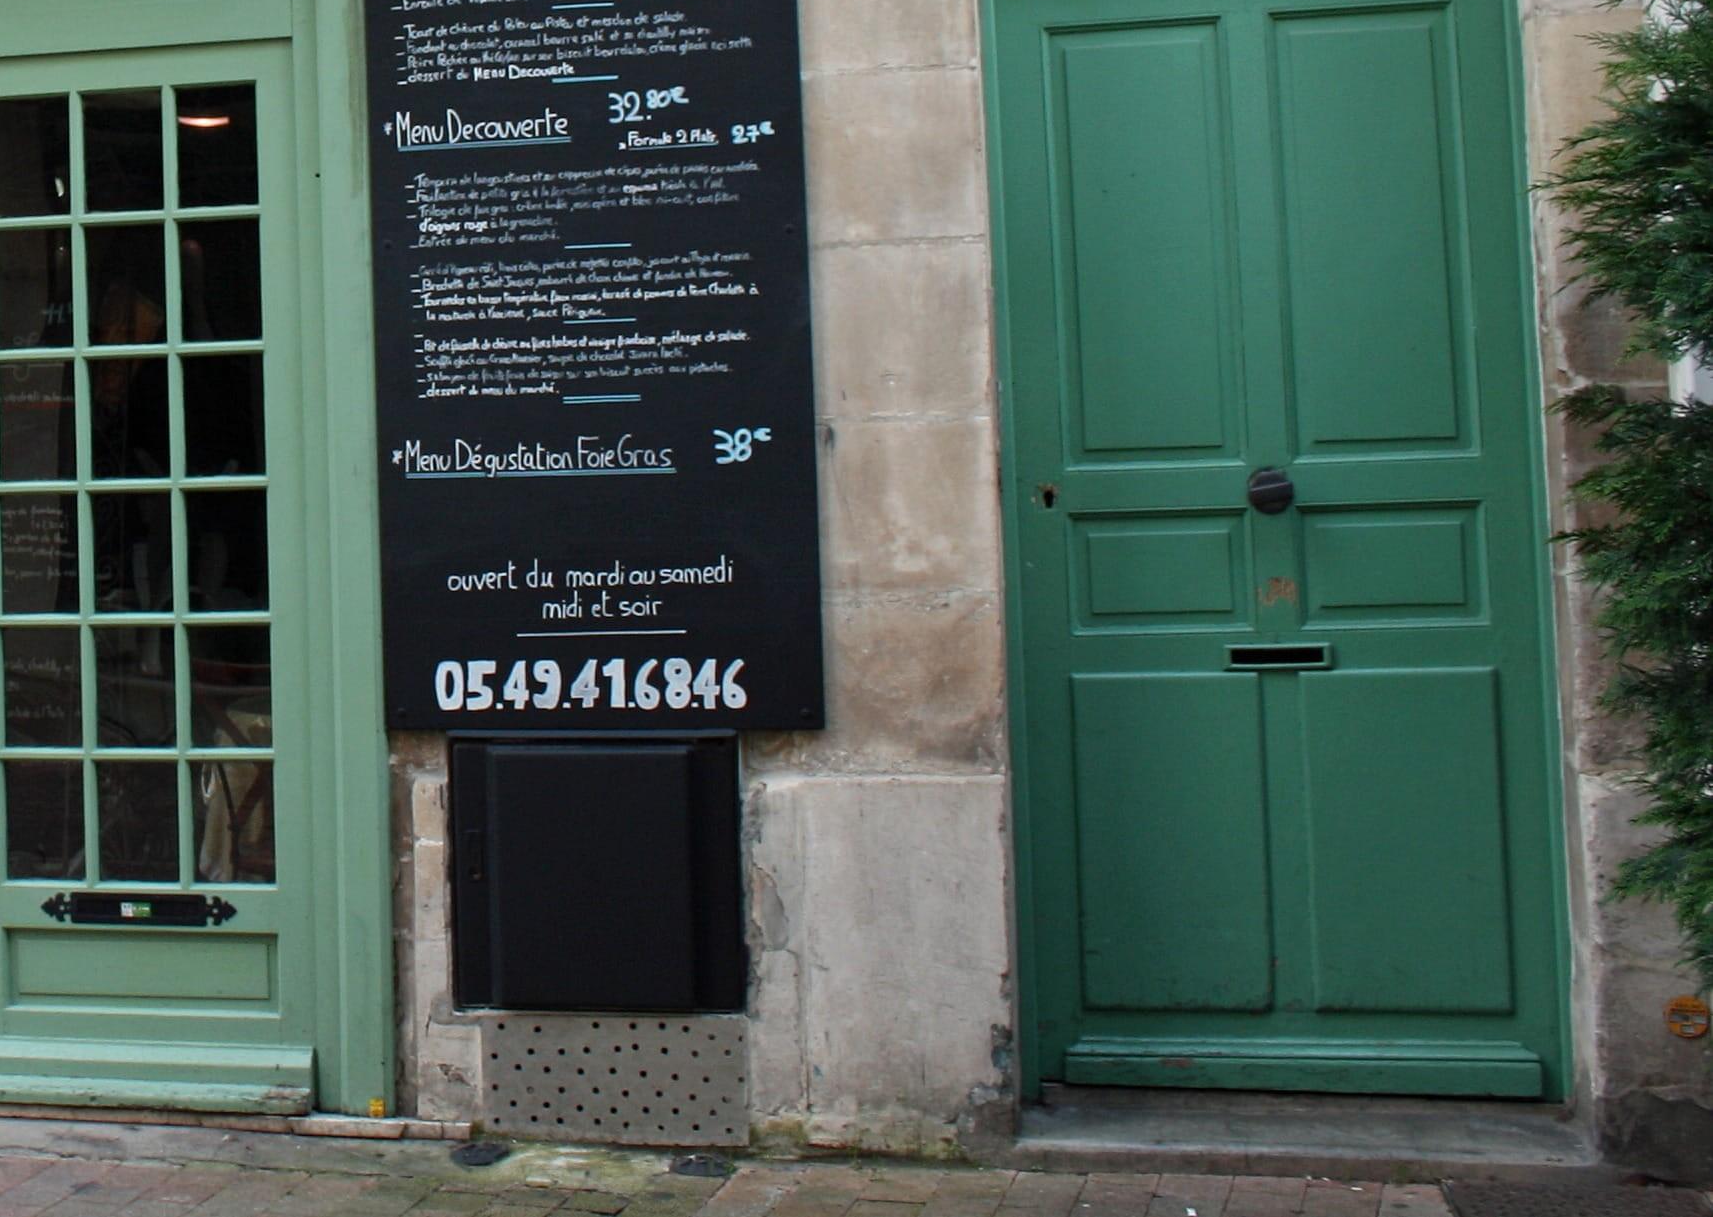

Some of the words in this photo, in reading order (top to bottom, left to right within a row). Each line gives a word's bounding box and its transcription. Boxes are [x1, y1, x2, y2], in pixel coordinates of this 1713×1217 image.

[609, 86, 689, 123] 32.80€
[396, 112, 444, 145] Menu
[447, 108, 568, 143] Decouverte
[676, 129, 687, 143] 2
[732, 121, 775, 144] 27€
[405, 440, 451, 472] Menu
[455, 439, 574, 477] Dégustation
[578, 436, 615, 468] Foie
[617, 434, 672, 467] Gras
[714, 428, 771, 464] 38€
[448, 561, 518, 591] ouvert
[526, 559, 554, 588] du
[566, 560, 624, 588] mardi
[629, 571, 656, 585] au
[660, 555, 733, 584] samedi
[543, 590, 582, 619] midi
[592, 590, 613, 617] et
[619, 595, 662, 616] soir
[435, 658, 747, 710] 05.49.41.68.46
